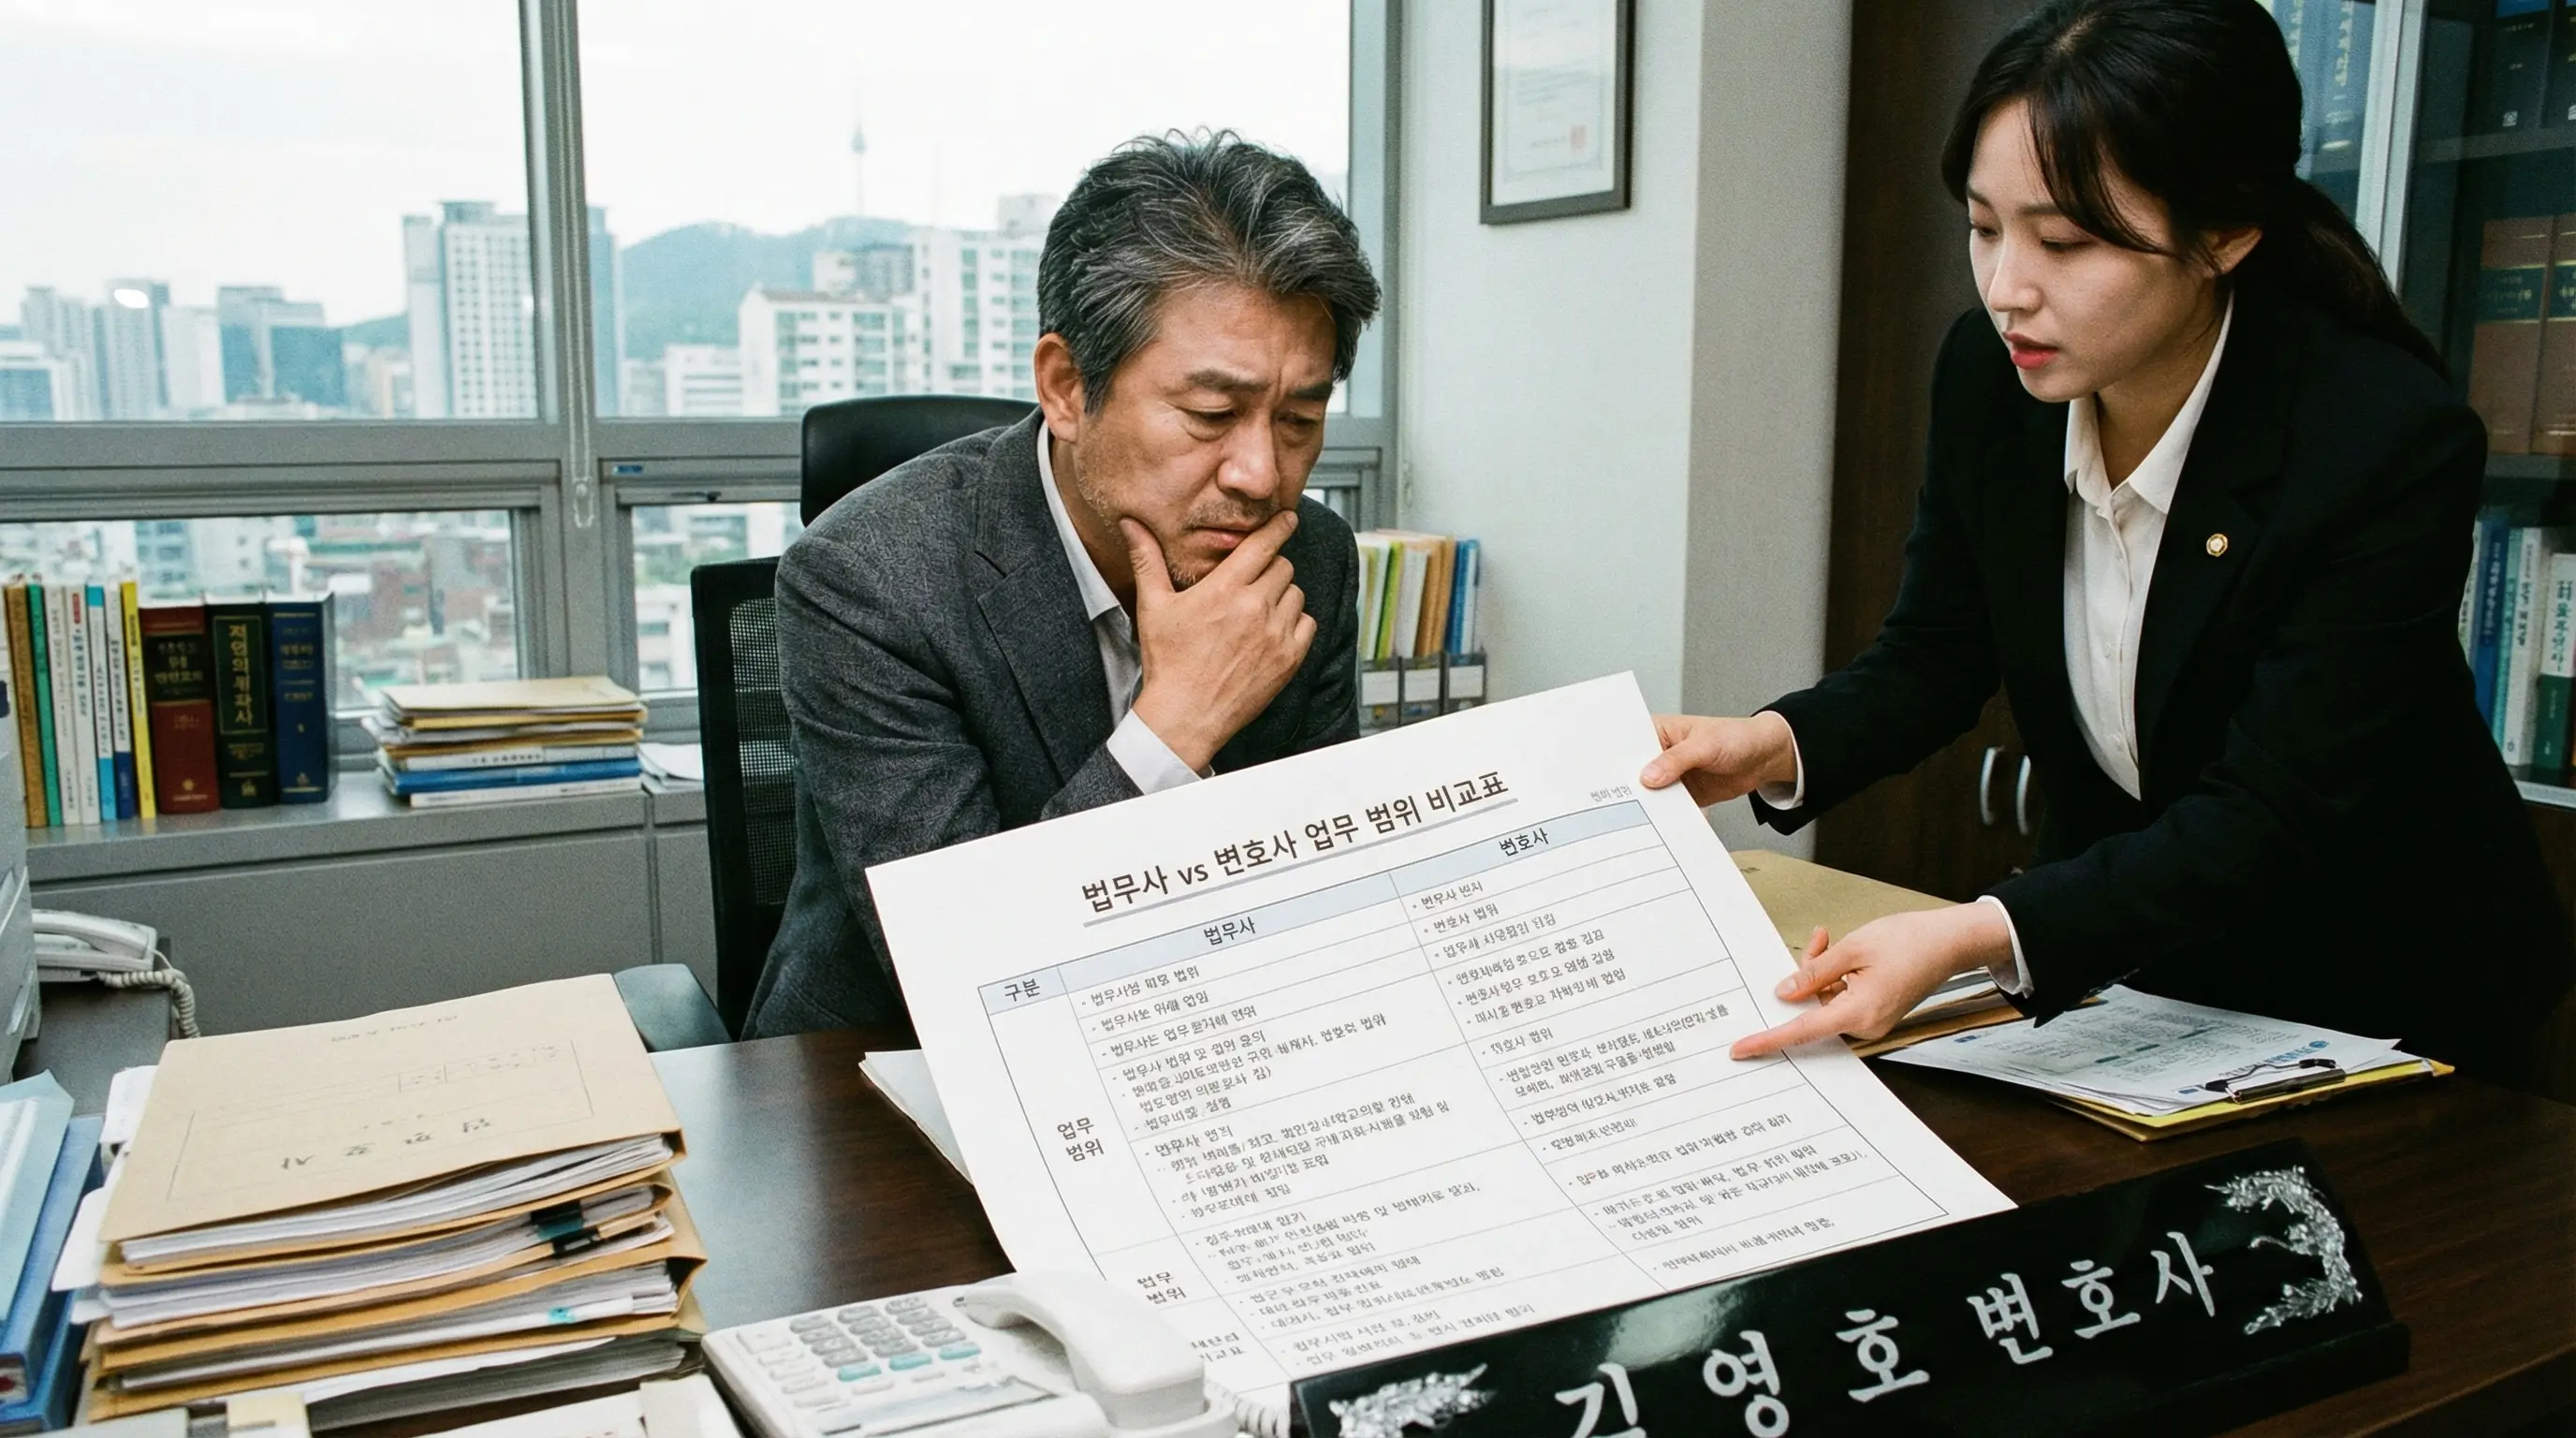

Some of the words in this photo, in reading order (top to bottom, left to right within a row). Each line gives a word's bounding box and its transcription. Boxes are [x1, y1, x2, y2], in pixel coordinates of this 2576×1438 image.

[1082, 865, 1168, 913] 법무사
[1177, 863, 1209, 886] vs
[1214, 830, 1297, 876] 변호사
[1304, 814, 1359, 852] 업무
[1365, 795, 1422, 834] 범위
[1426, 771, 1508, 811] 비교표
[1003, 978, 1041, 1003] 구분
[1203, 917, 1256, 946] 법무사
[1499, 828, 1549, 857] 변호사
[1057, 1117, 1094, 1140] 업무
[1065, 1137, 1105, 1162] 범위
[1555, 1309, 1930, 1438] 김영호
[1967, 1231, 2215, 1364] 변호사
